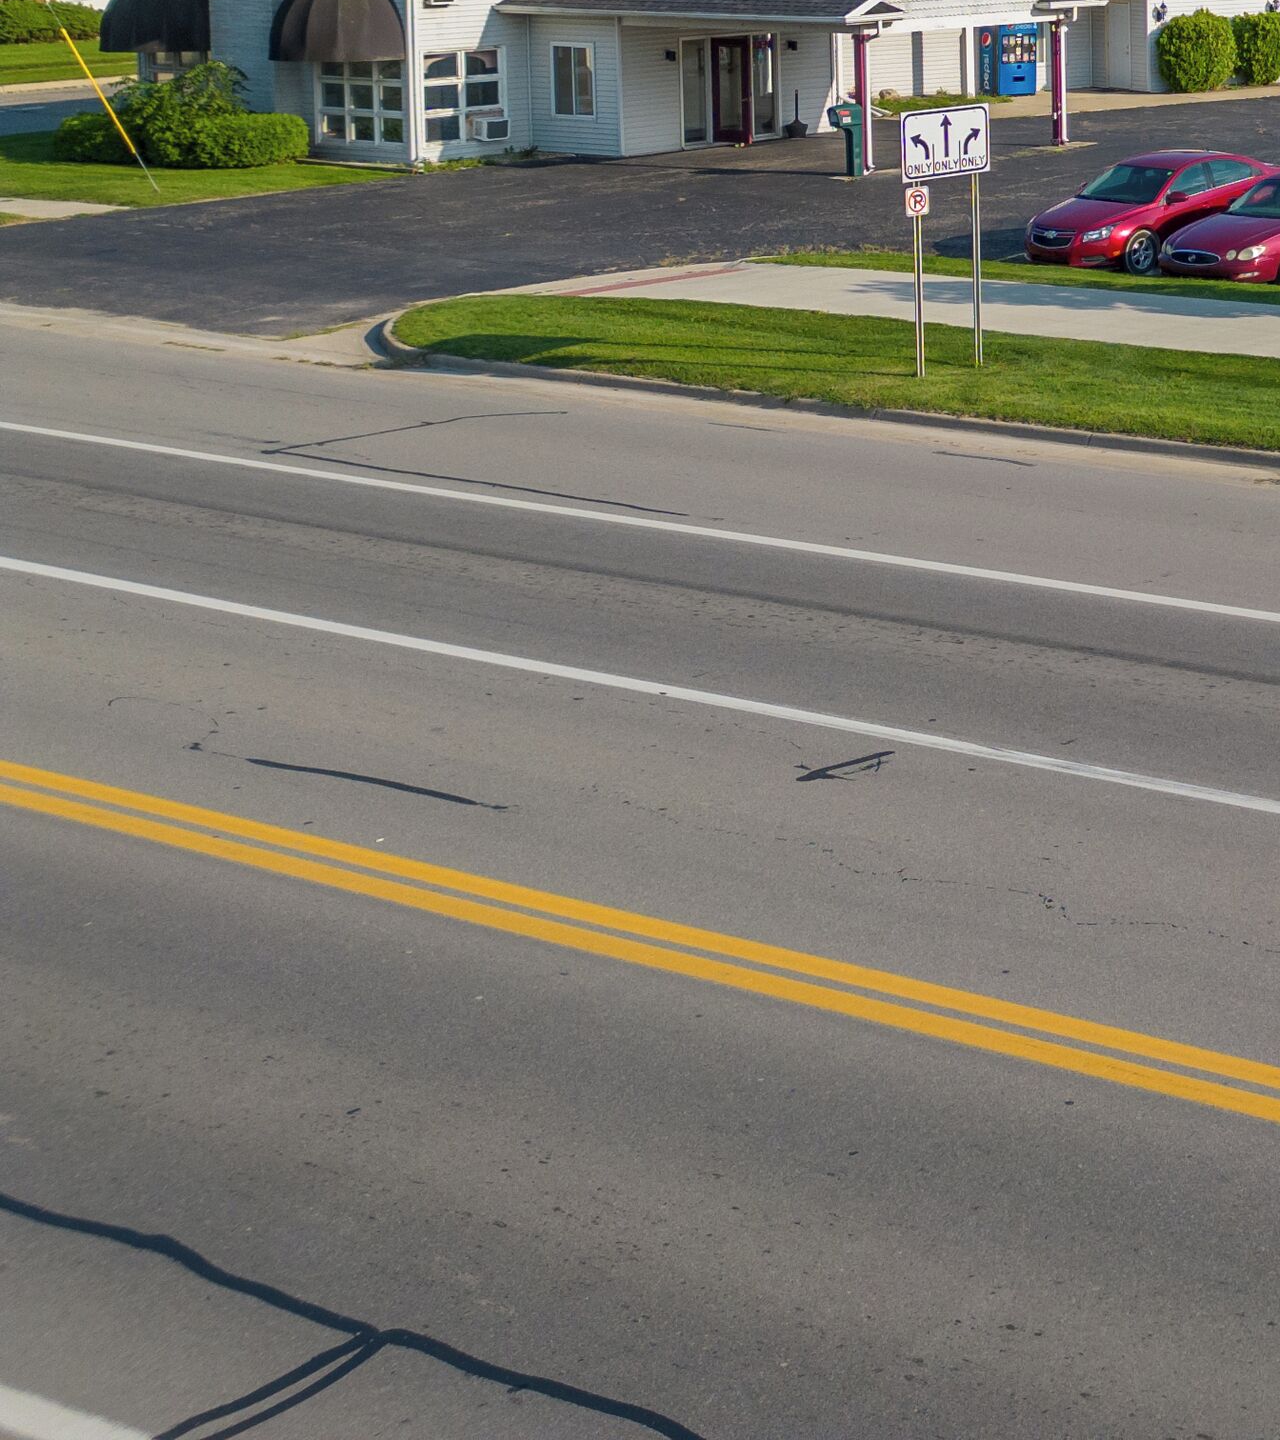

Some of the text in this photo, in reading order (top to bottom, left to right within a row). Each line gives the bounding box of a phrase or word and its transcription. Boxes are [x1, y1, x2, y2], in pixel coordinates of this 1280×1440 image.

[983, 53, 991, 90] pepsi
[907, 155, 985, 175] ONLY ONLY ONLY
